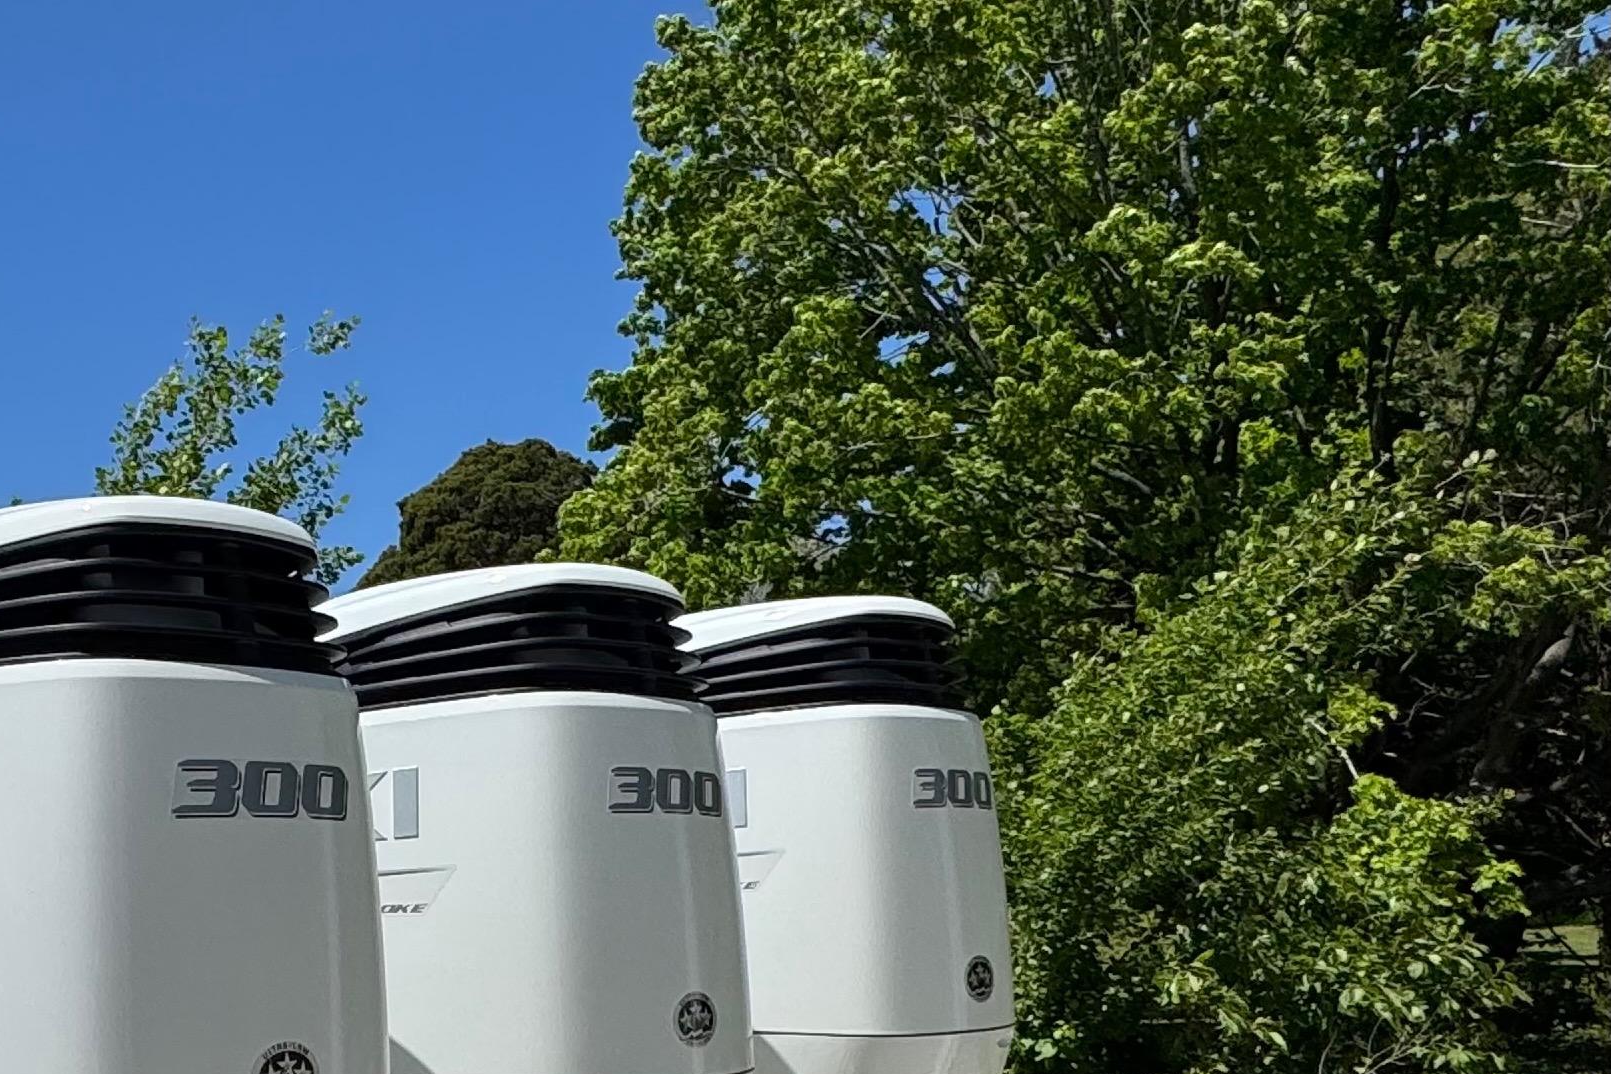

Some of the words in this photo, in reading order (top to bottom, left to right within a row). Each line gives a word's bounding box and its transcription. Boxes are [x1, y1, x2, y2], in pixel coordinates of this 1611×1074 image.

[171, 759, 349, 821] 300
[608, 766, 723, 818] 300
[913, 768, 993, 810] 300
